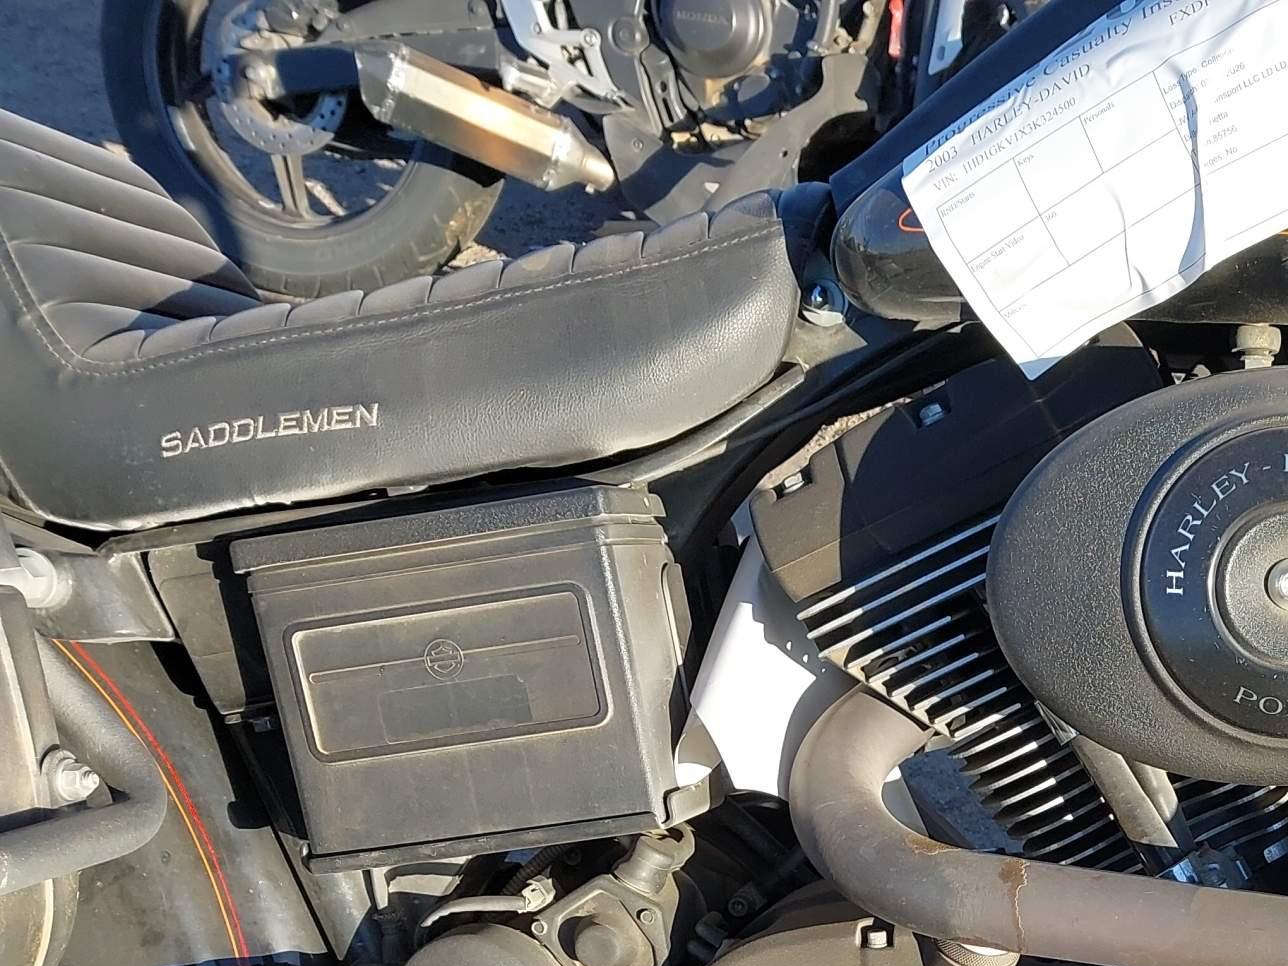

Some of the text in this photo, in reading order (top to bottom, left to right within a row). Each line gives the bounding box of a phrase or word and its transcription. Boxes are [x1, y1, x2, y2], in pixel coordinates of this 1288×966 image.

[1043, 16, 1133, 77] Casualty
[928, 146, 958, 173] 2003
[971, 63, 1091, 146] HARLEY-DAVID
[932, 172, 958, 192] VIN:
[161, 403, 379, 458] SADDLEMEN
[1166, 462, 1250, 596] HARLEY
